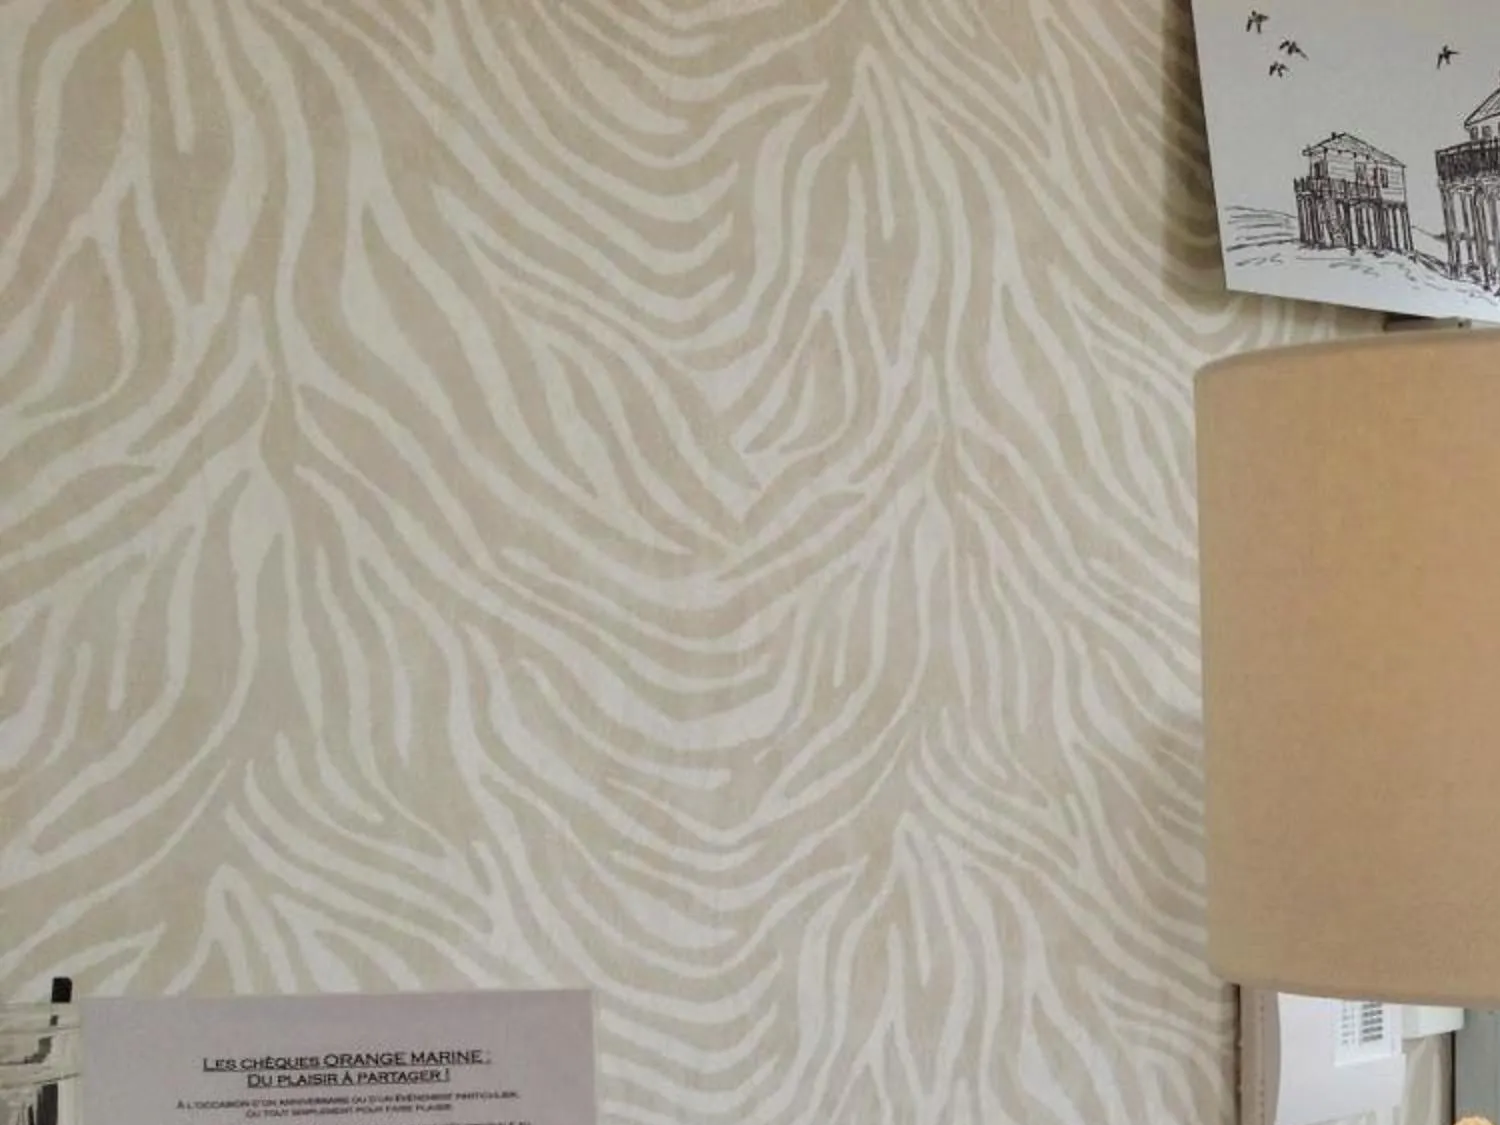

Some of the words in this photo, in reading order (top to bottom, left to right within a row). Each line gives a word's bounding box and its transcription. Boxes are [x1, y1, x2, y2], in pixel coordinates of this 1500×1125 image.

[203, 1057, 237, 1072] LES
[323, 1052, 407, 1067] ORANGE
[410, 1050, 483, 1065] MARINE
[248, 1073, 273, 1088] DU
[277, 1073, 339, 1087] PLAISIR
[357, 1069, 441, 1084] PARTAGER
